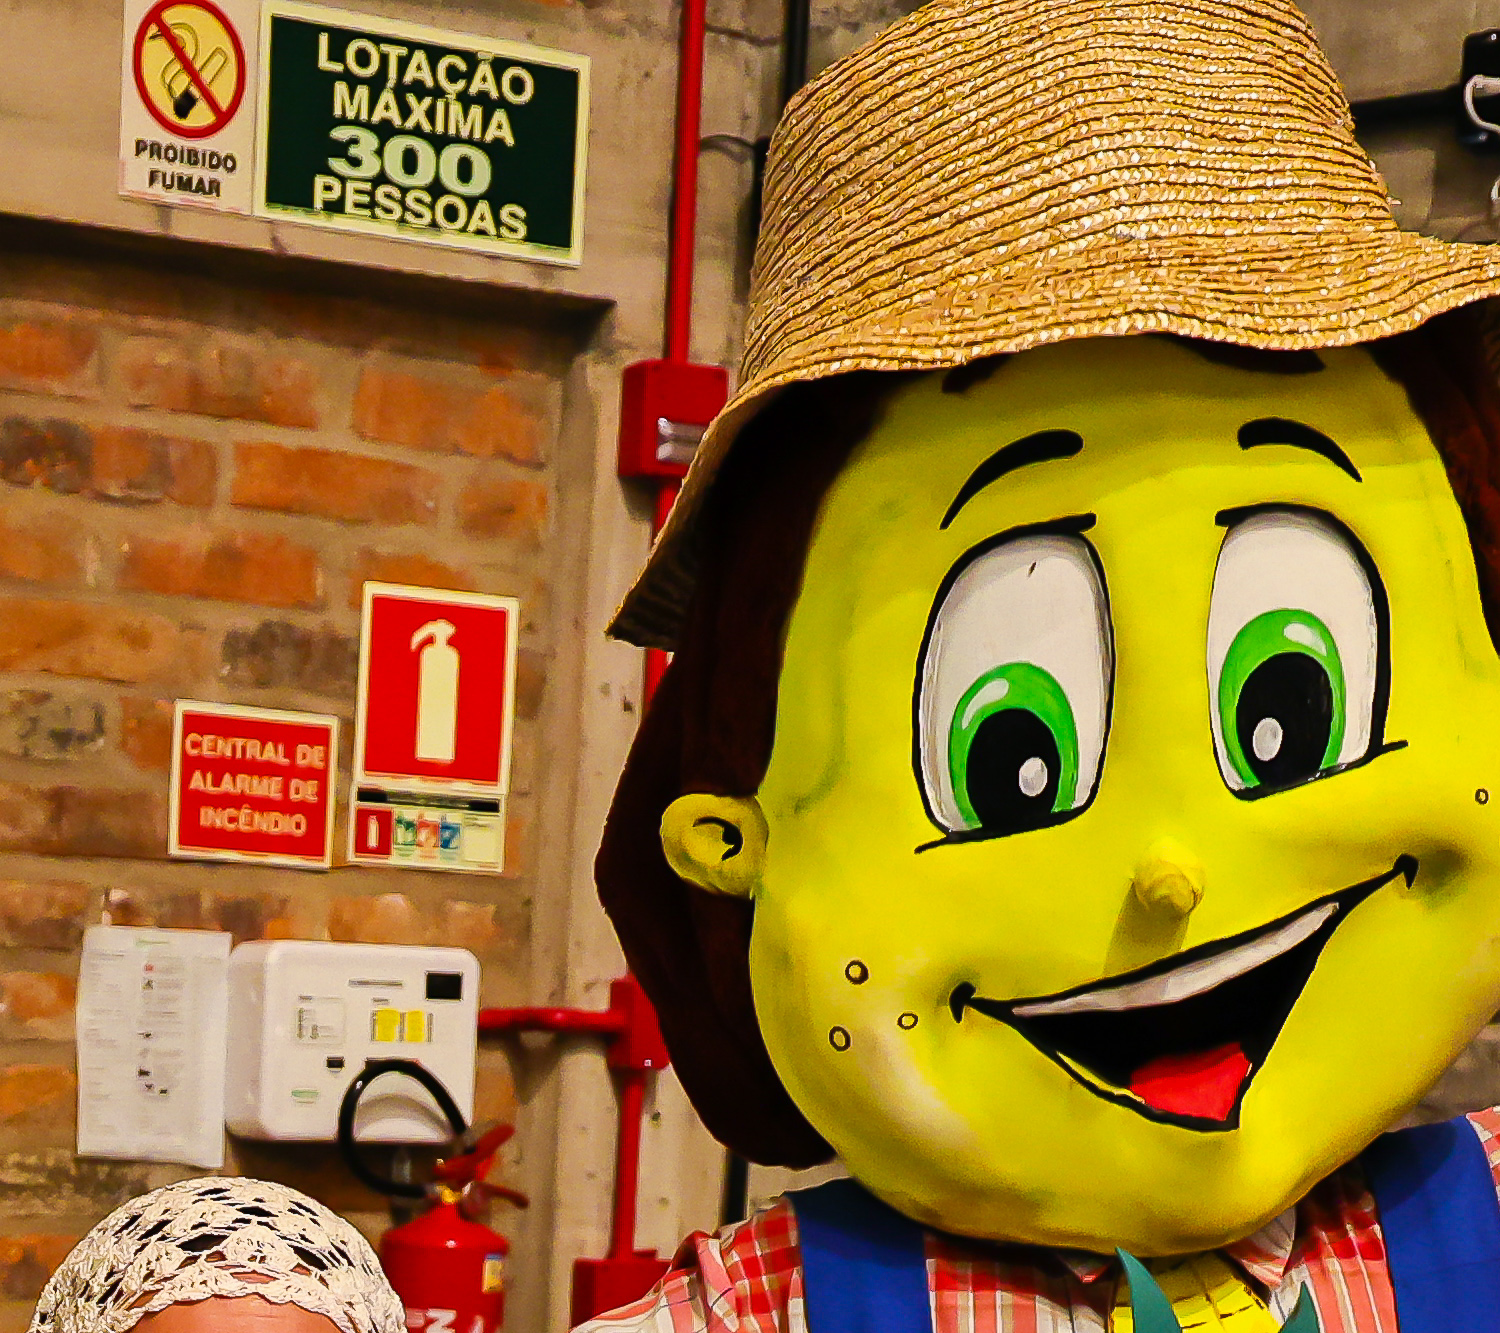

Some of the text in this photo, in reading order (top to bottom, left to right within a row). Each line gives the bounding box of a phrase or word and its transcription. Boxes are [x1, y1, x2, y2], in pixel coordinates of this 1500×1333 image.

[317, 32, 535, 105] LOTAÇÃO
[333, 79, 515, 147] MÁXIMA
[135, 138, 237, 173] PROIBIDO
[327, 124, 492, 197] 300
[148, 168, 221, 197] FUMAR
[313, 173, 528, 240] PESSOAS
[185, 732, 326, 770] CENTRAL DE
[189, 769, 319, 804] ALARME DE
[200, 803, 308, 838] INCÊNDIO
